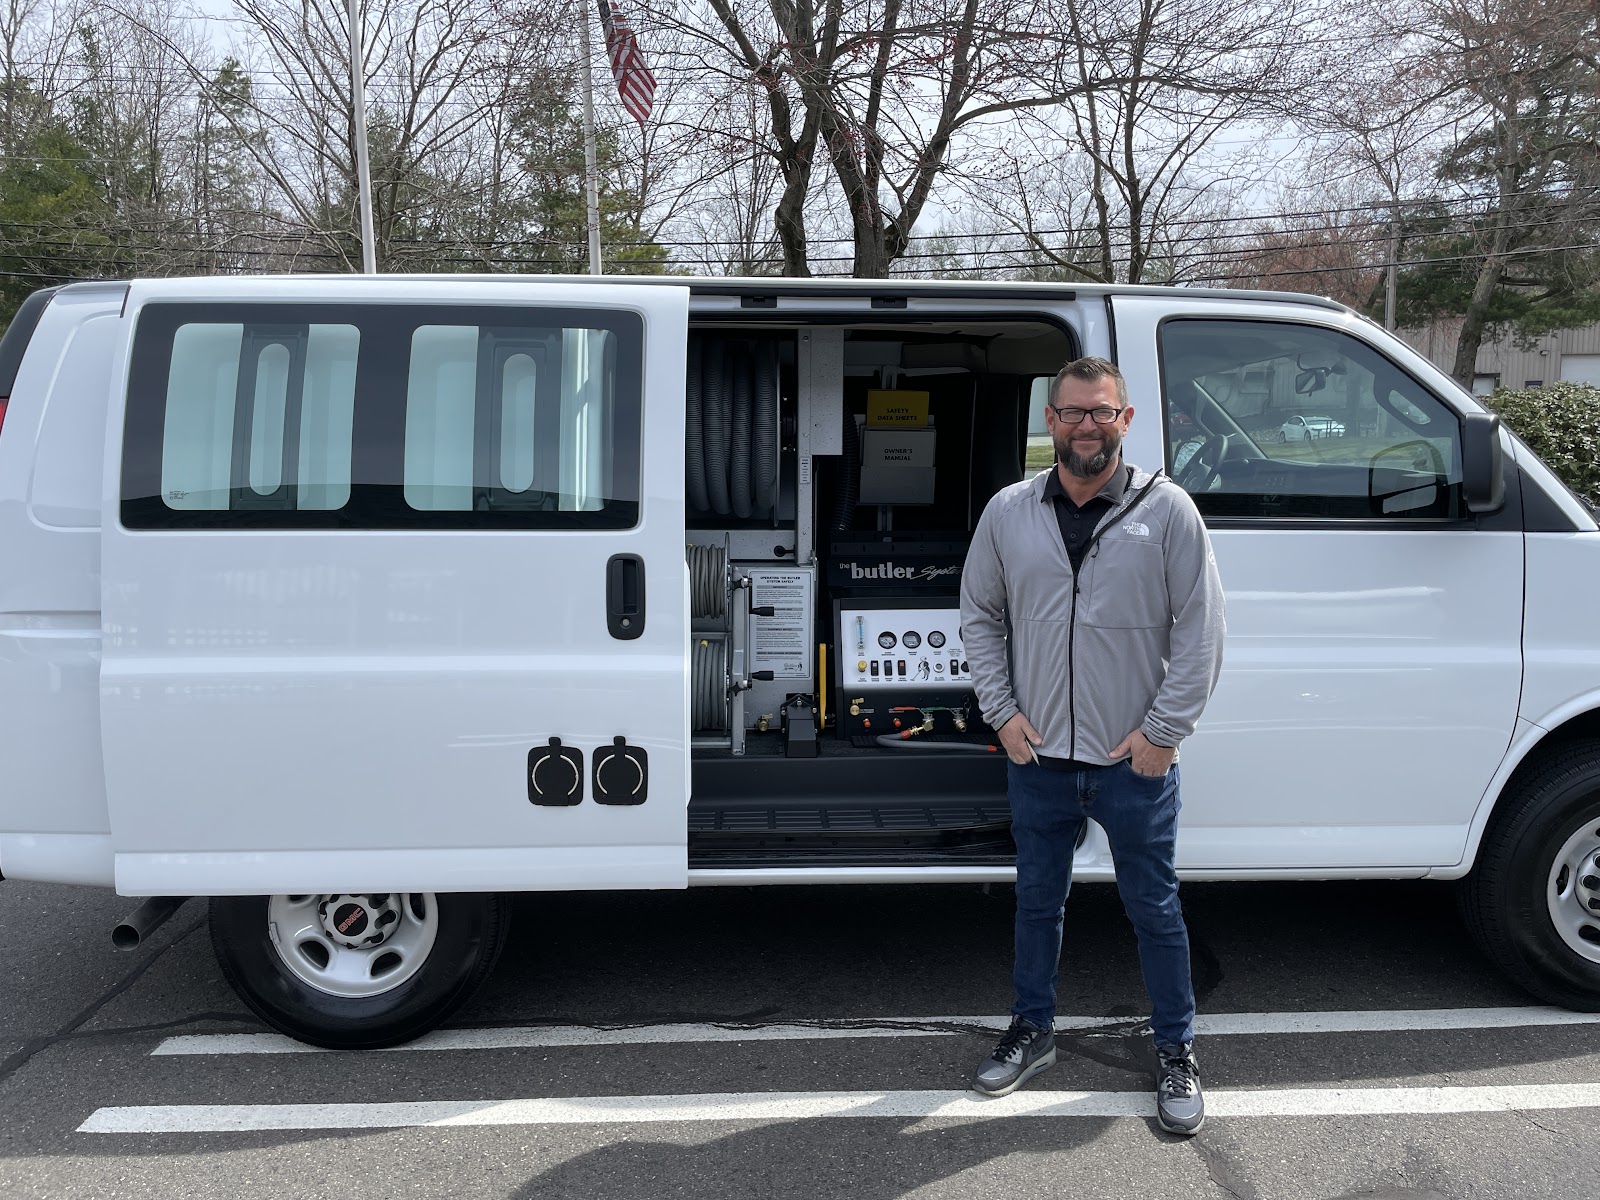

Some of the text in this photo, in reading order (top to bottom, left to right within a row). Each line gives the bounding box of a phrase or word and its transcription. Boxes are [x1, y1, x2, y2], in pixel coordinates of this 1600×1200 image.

[850, 561, 915, 580] butler
[910, 565, 963, 581] Syst
[338, 907, 364, 932] GMC
